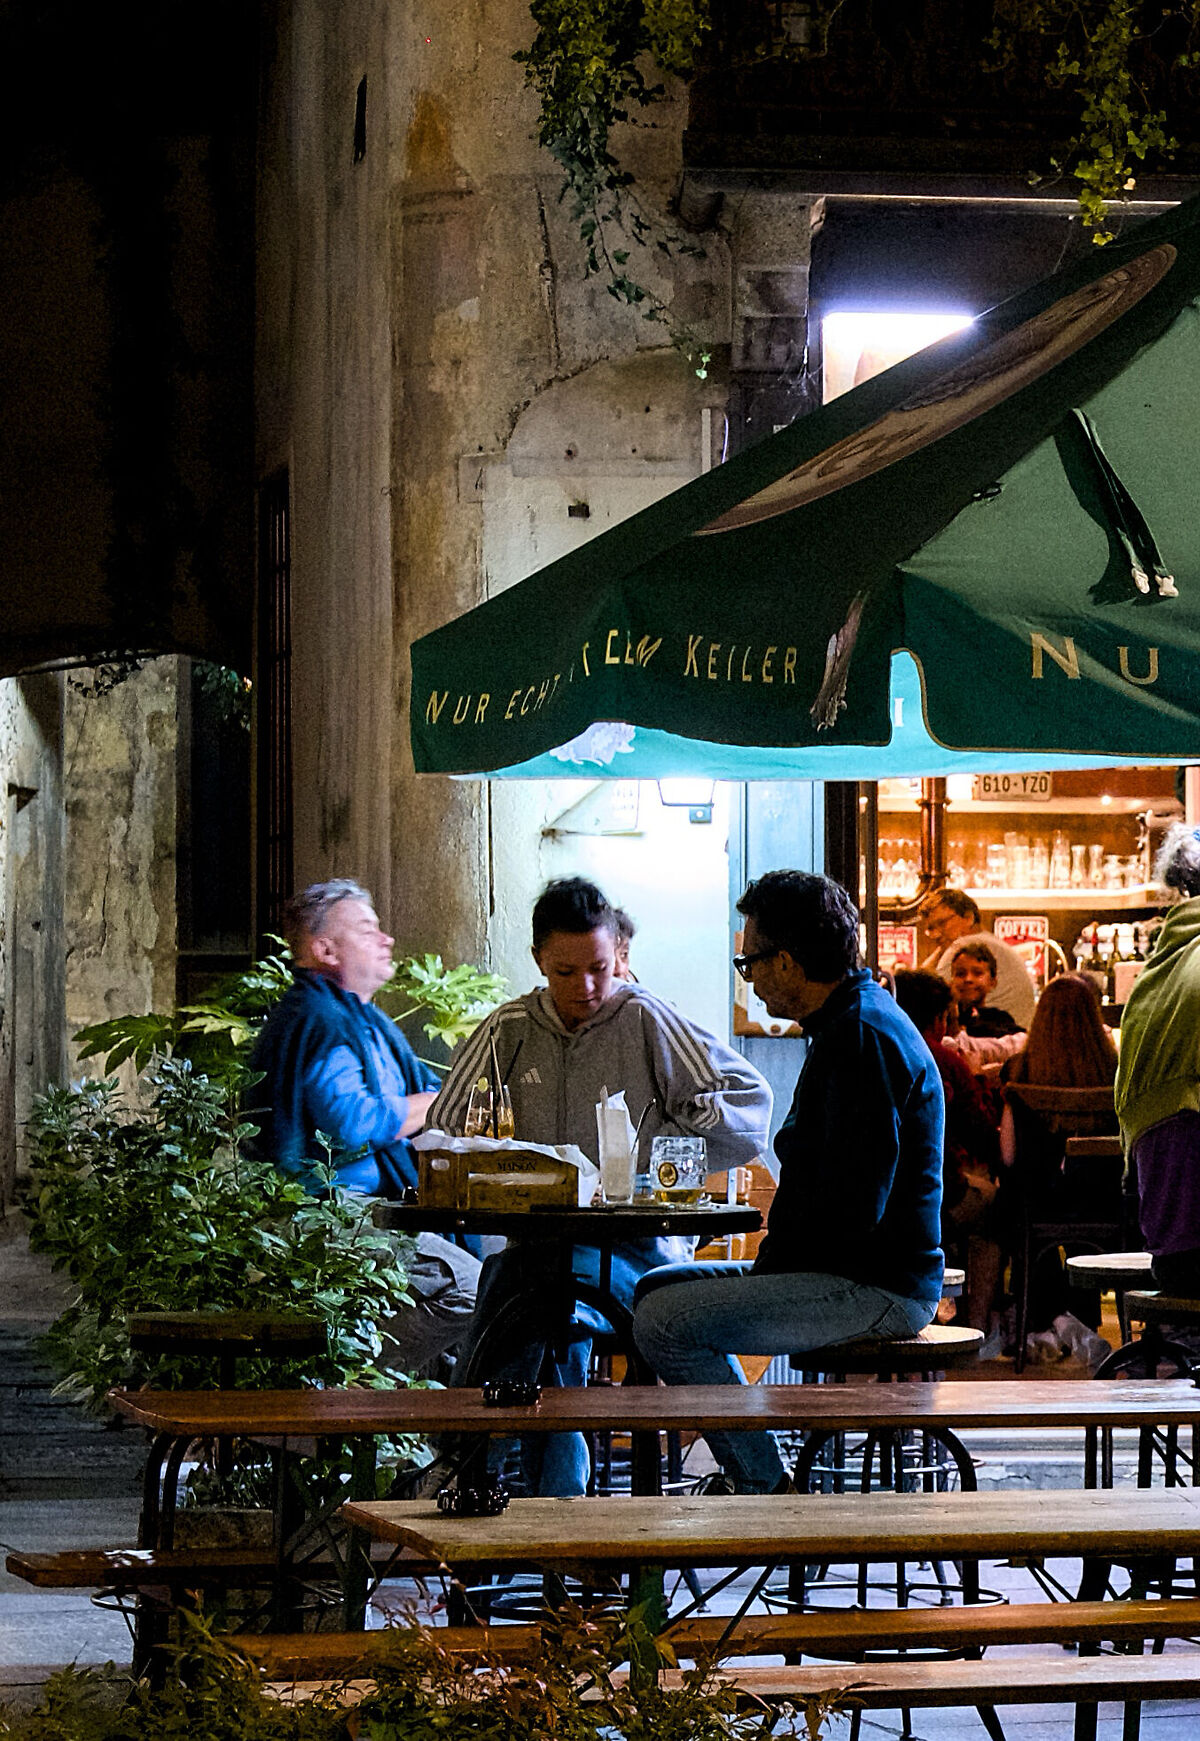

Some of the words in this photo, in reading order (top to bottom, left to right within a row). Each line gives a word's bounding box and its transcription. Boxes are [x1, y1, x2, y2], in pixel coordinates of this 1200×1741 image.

[426, 690, 490, 725] NUR
[684, 634, 798, 685] KEILER
[998, 919, 1046, 939] COFFEE
